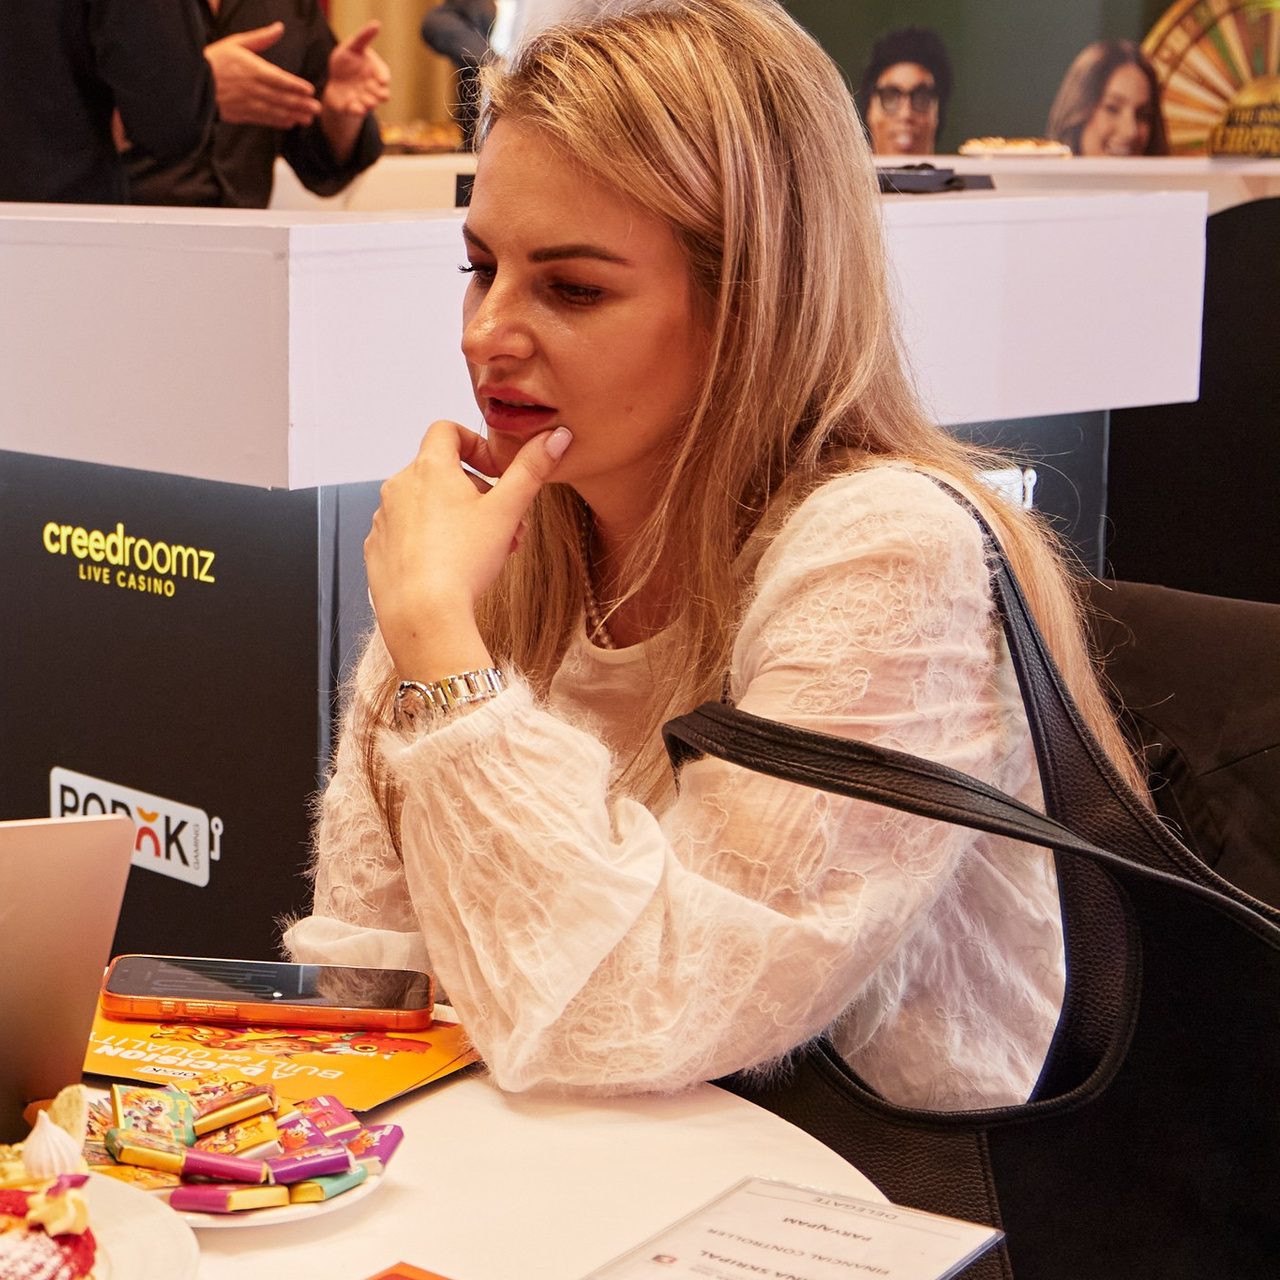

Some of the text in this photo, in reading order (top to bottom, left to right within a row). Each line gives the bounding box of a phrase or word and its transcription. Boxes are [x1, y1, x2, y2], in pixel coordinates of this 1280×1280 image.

[43, 522, 215, 583] creedroomz
[79, 563, 175, 597] LIVE CASINO
[217, 1052, 252, 1063] on
[251, 1059, 344, 1079] BUILT
[271, 1069, 298, 1080] A
[813, 1197, 898, 1220] DELEGATE
[782, 1217, 872, 1242] PARYAJPAM
[700, 1250, 768, 1274] SKRIPAL
[707, 1228, 891, 1276] FINANCIAL CONTROLLER
